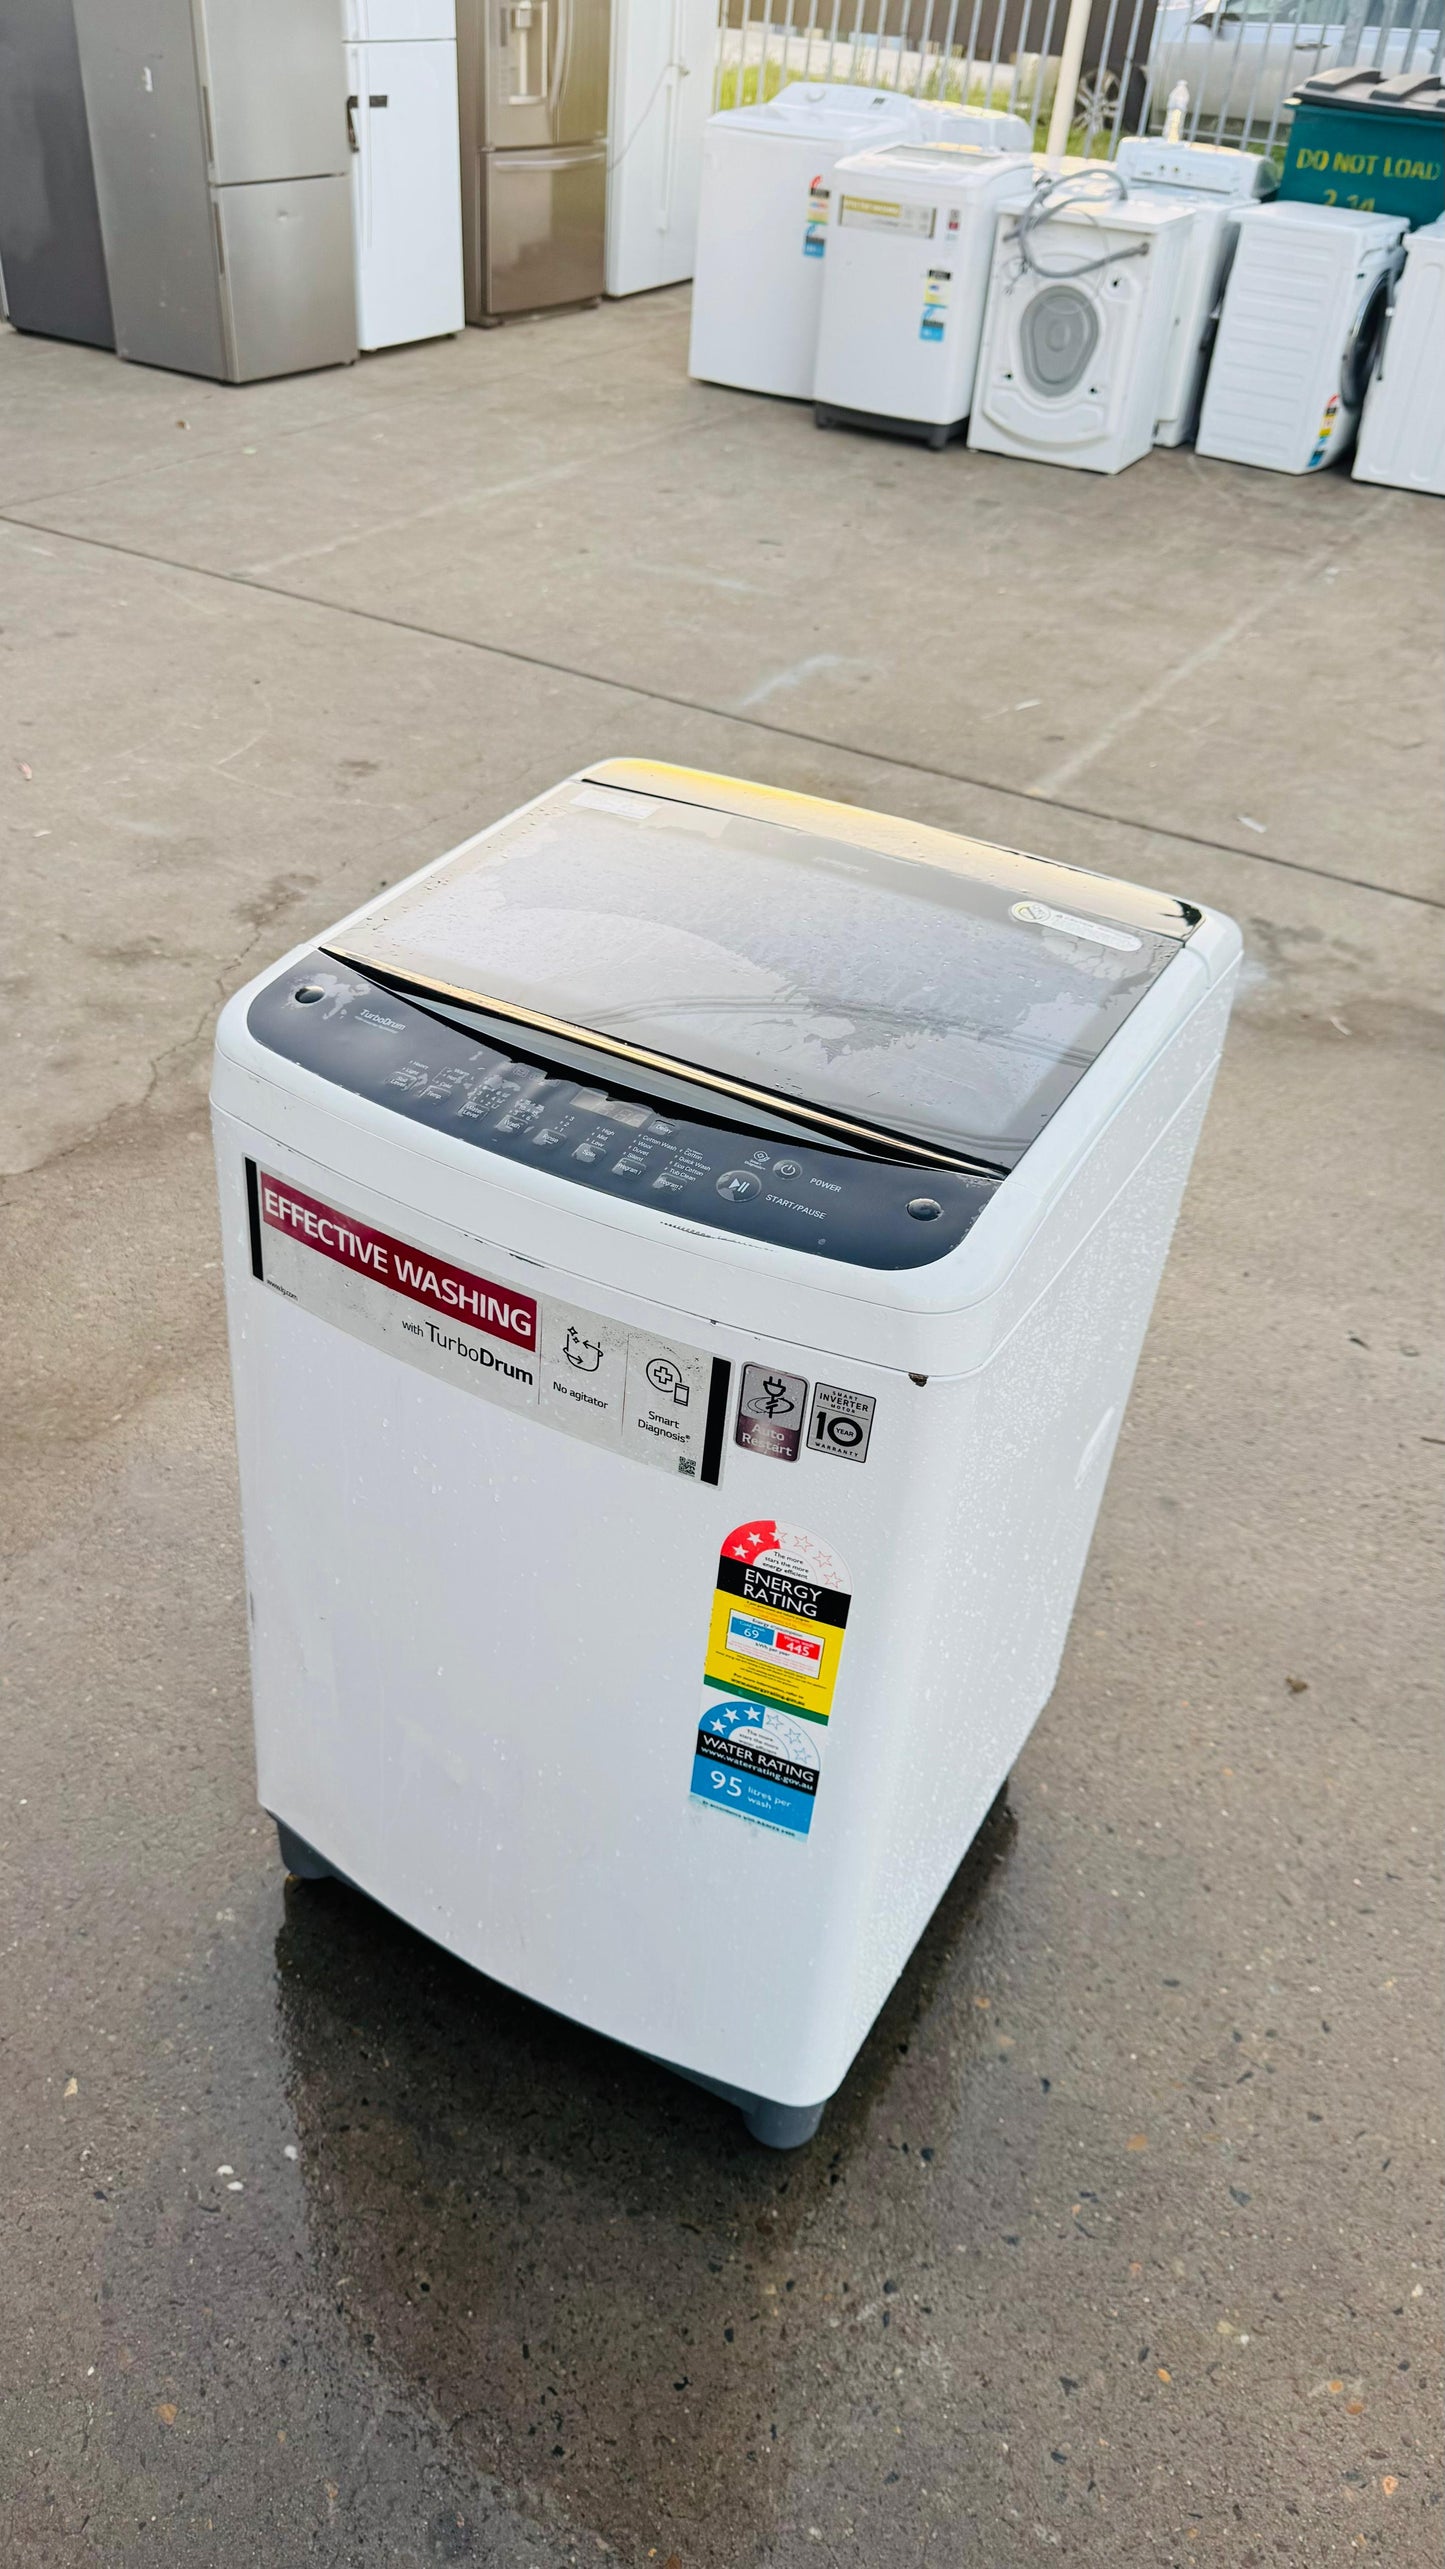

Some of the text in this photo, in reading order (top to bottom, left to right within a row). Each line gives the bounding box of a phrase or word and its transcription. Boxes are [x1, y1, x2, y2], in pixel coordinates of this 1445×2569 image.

[1296, 148, 1440, 181] DO NOT LOAD
[360, 1008, 406, 1031] TurboDrum
[632, 1146, 650, 1157] Duvet
[642, 1134, 662, 1146] Cotton
[661, 1140, 678, 1152] Wash
[809, 1177, 842, 1193] POWER
[765, 1194, 828, 1220] START/PAUSE
[263, 1187, 532, 1337] EFFECTIVE WASHING
[401, 1320, 534, 1386] with TurboDrum
[552, 1381, 609, 1409] No agitator
[819, 1392, 869, 1413] INVERTER
[832, 1391, 858, 1401] SMART
[648, 1410, 680, 1430] Smart
[830, 1403, 856, 1414] MOTOR
[751, 1423, 785, 1441] Auto
[816, 1411, 864, 1448] 10
[836, 1427, 855, 1438] YEAR
[741, 1432, 793, 1457] Restart
[814, 1441, 859, 1457] WARRANTY
[744, 1567, 823, 1602] ENERGY
[743, 1583, 818, 1617] RATING
[743, 1628, 760, 1640] 69
[785, 1641, 811, 1657] 445
[700, 1746, 814, 1791] www.waterrating.gov.au
[702, 1734, 816, 1783] WATER RATING
[710, 1770, 742, 1797] 95
[747, 1785, 793, 1808] litres per
[747, 1796, 773, 1810] wash
